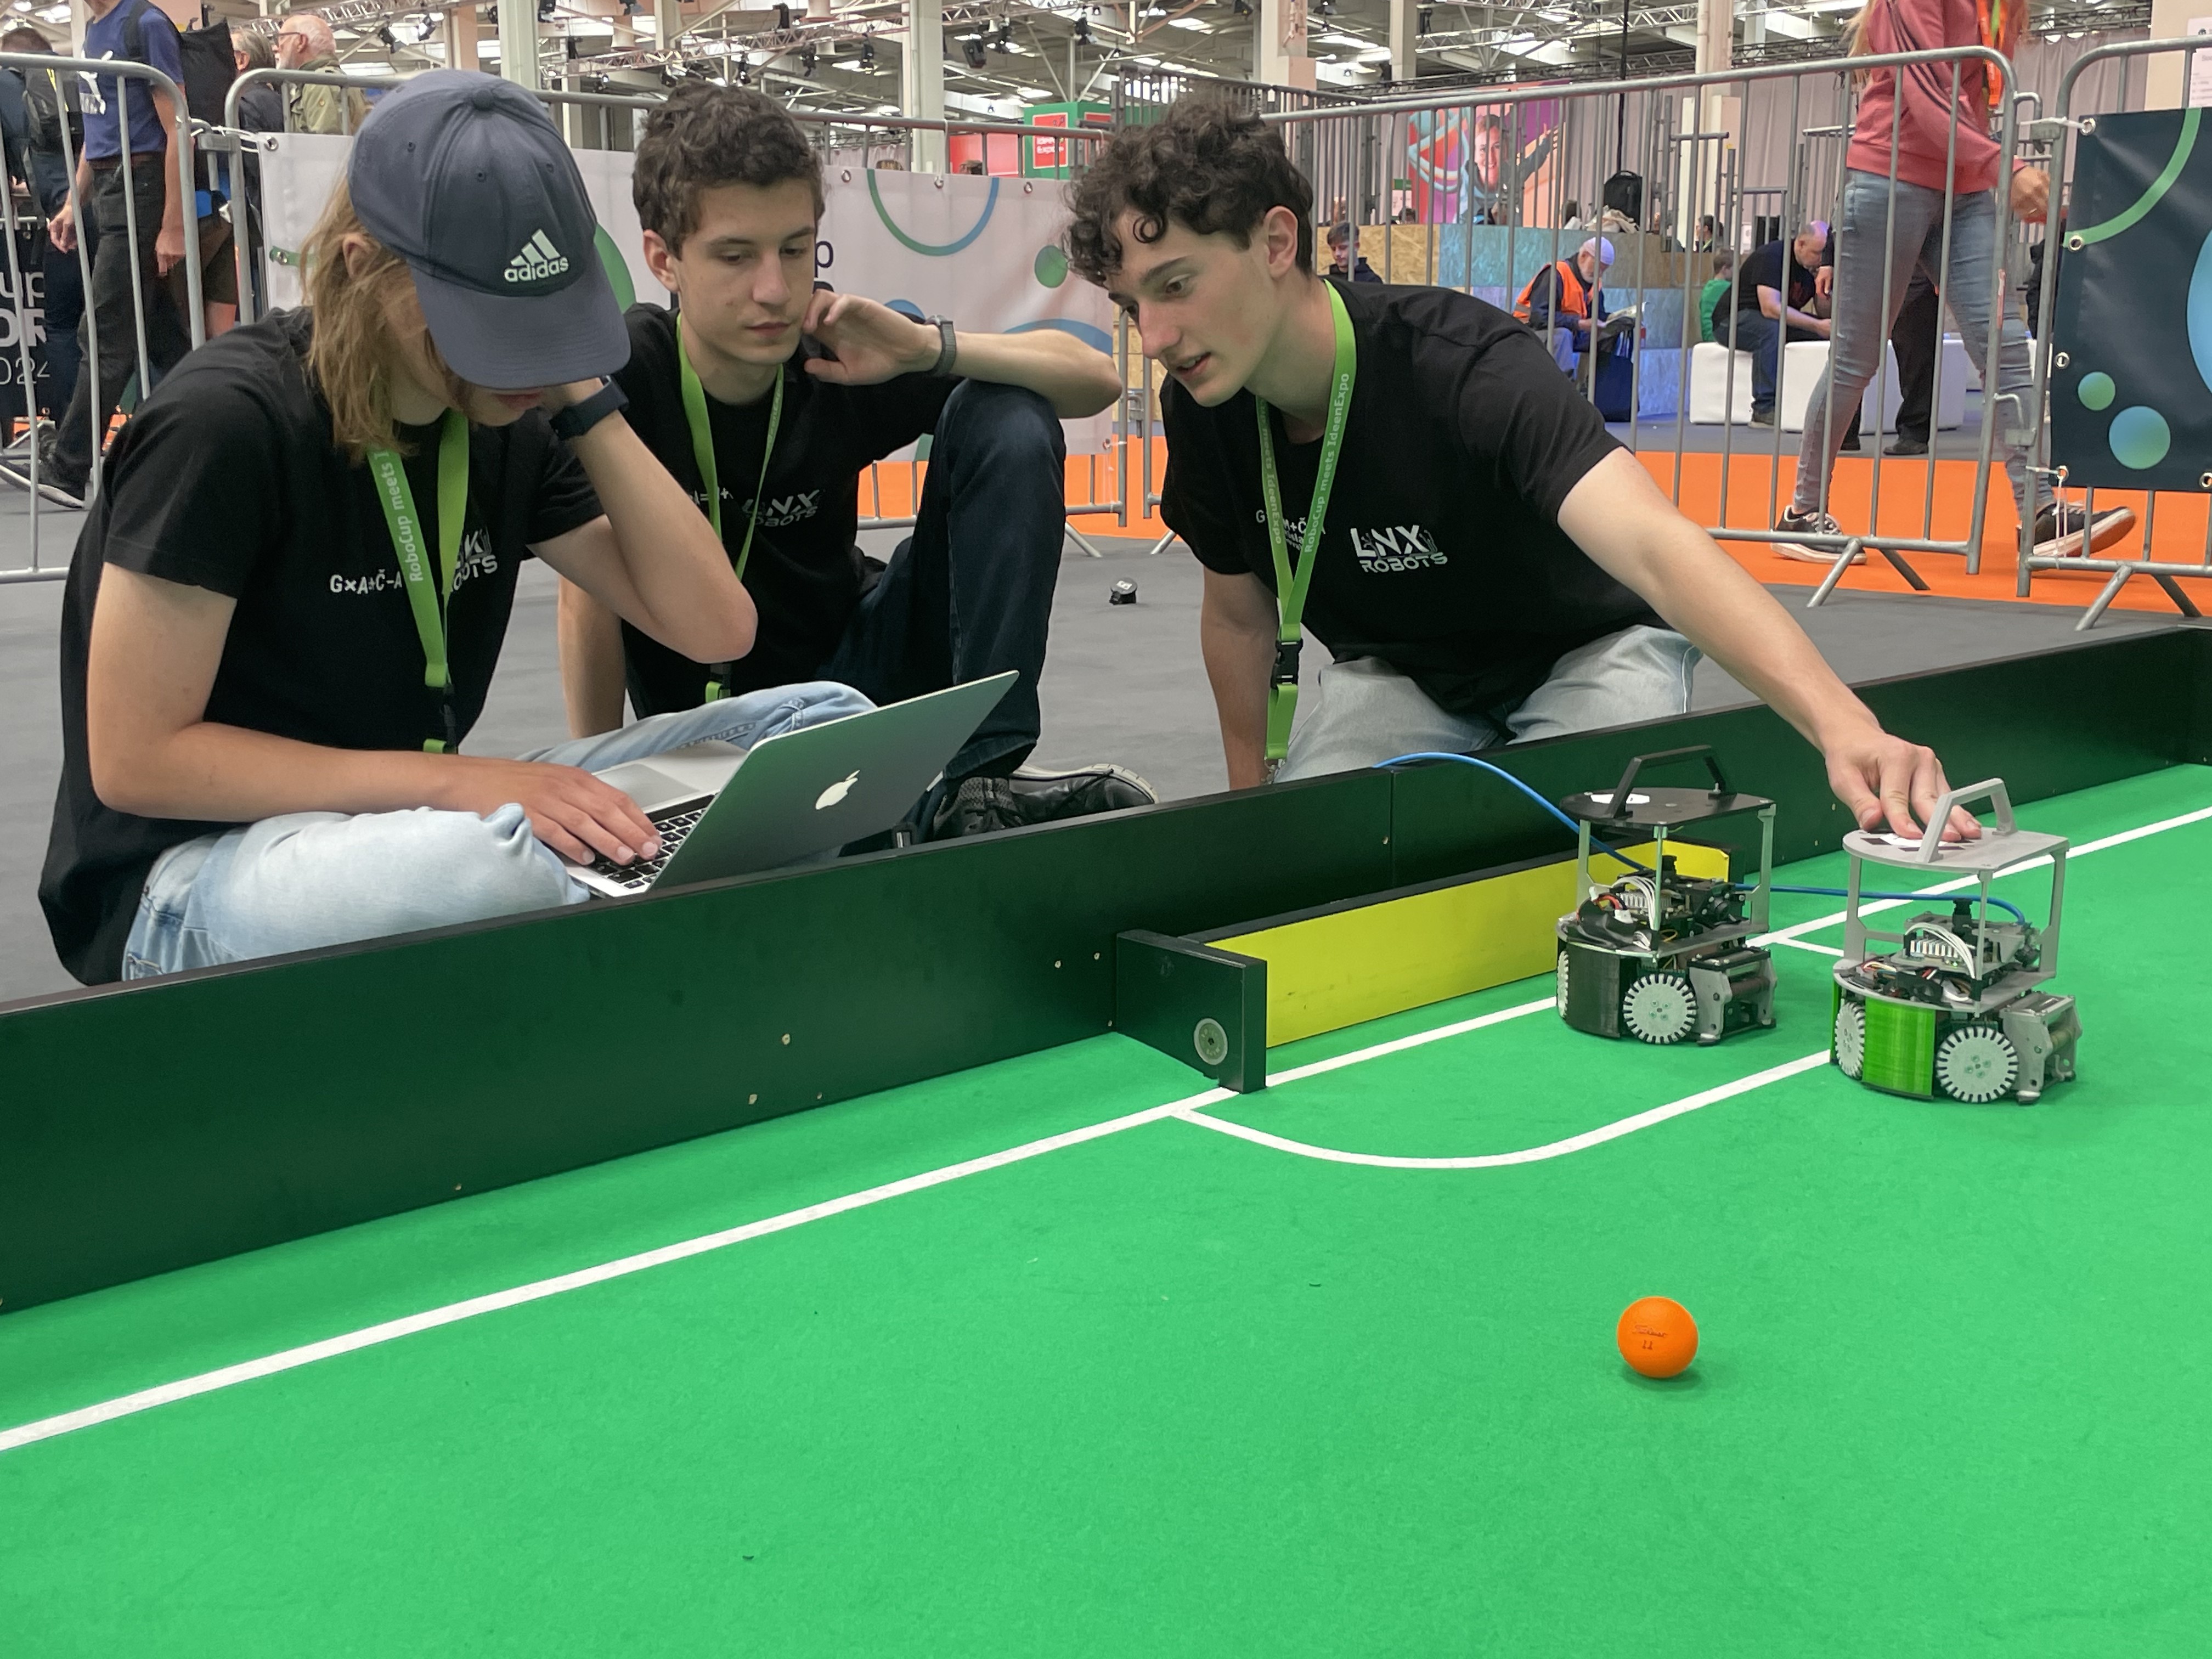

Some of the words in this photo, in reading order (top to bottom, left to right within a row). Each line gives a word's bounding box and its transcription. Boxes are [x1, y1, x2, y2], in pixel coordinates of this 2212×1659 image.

[504, 256, 569, 283] adidas
[381, 462, 405, 511] meets
[1304, 495, 1325, 553] RoboCup
[1319, 449, 1335, 492] meets
[1327, 373, 1350, 447] IdeenExpo
[1267, 473, 1282, 544] IdeenExpo
[398, 515, 424, 582] RoboCup
[1359, 552, 1448, 573] ROBOTS
